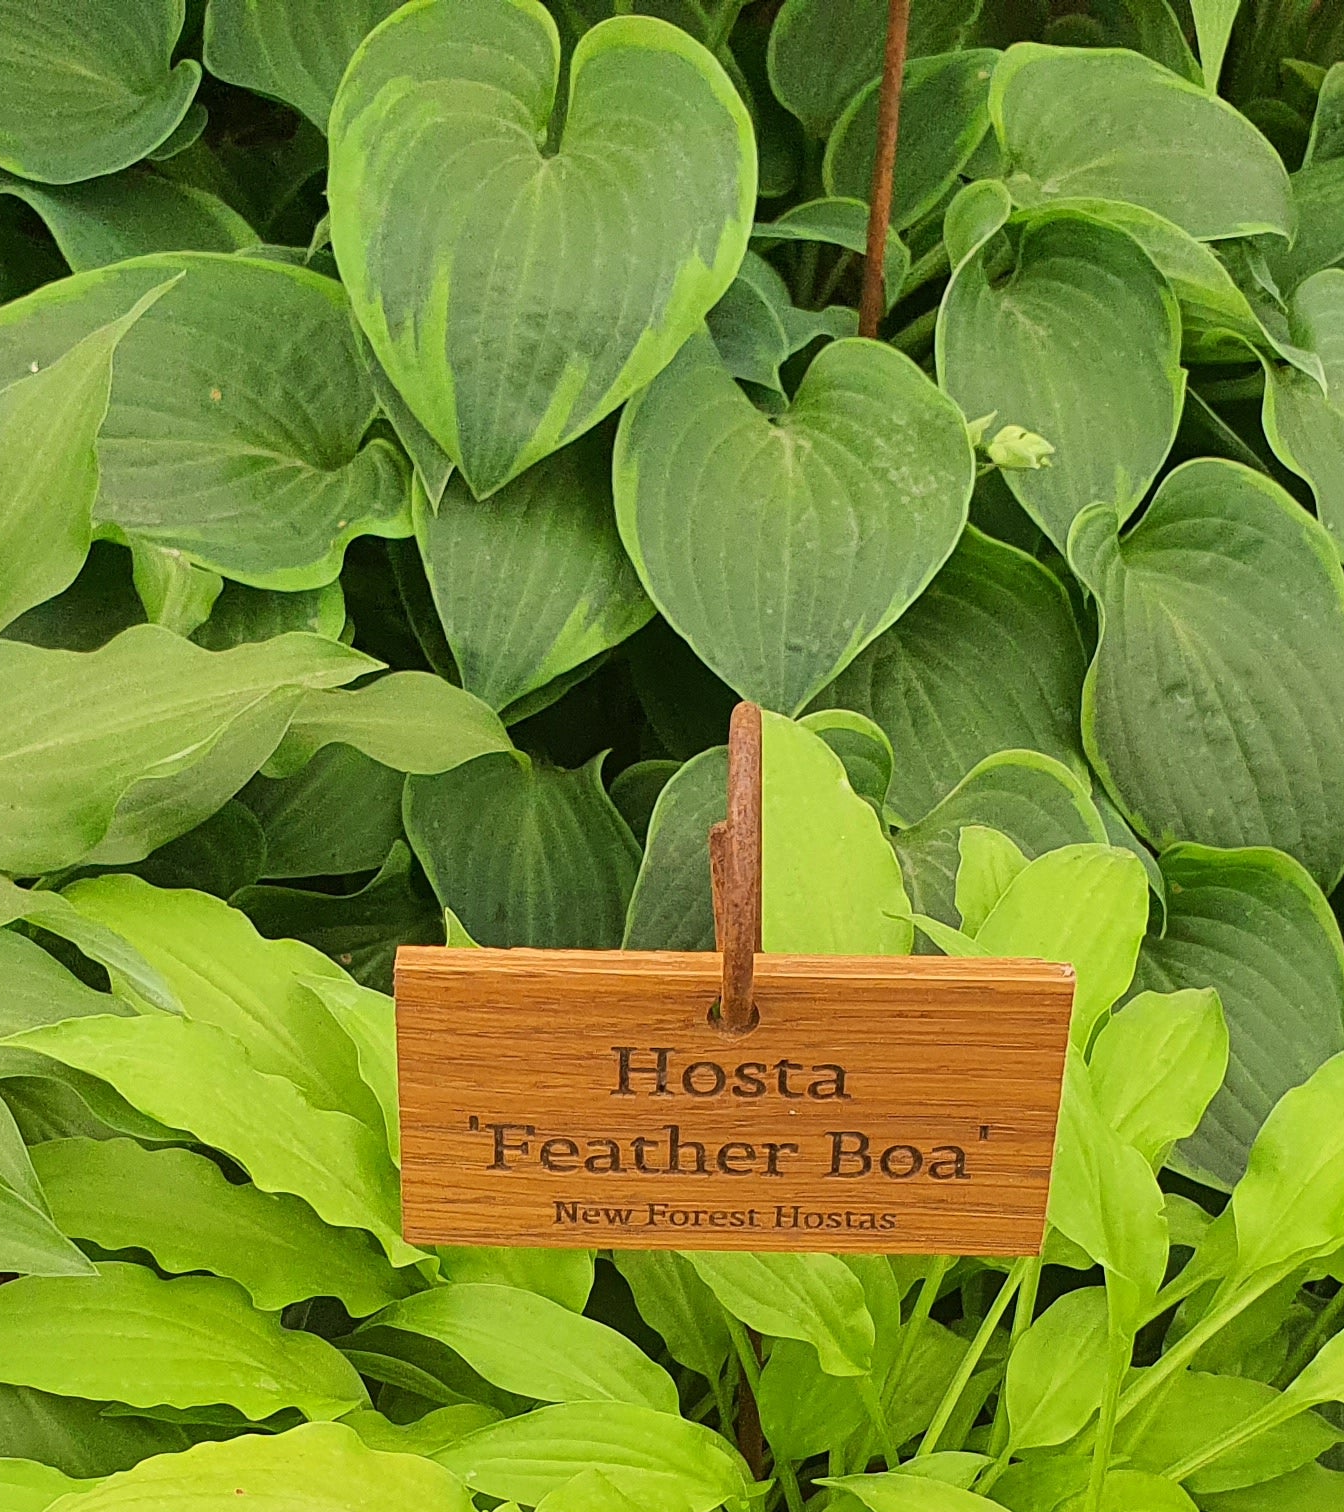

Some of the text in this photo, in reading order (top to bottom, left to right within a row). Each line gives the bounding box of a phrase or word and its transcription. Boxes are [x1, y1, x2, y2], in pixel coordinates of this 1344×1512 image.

[609, 1044, 853, 1101] Hosta
[467, 1113, 993, 1182] 'Feather Boa'
[552, 1200, 898, 1231] New Forest Hostas
